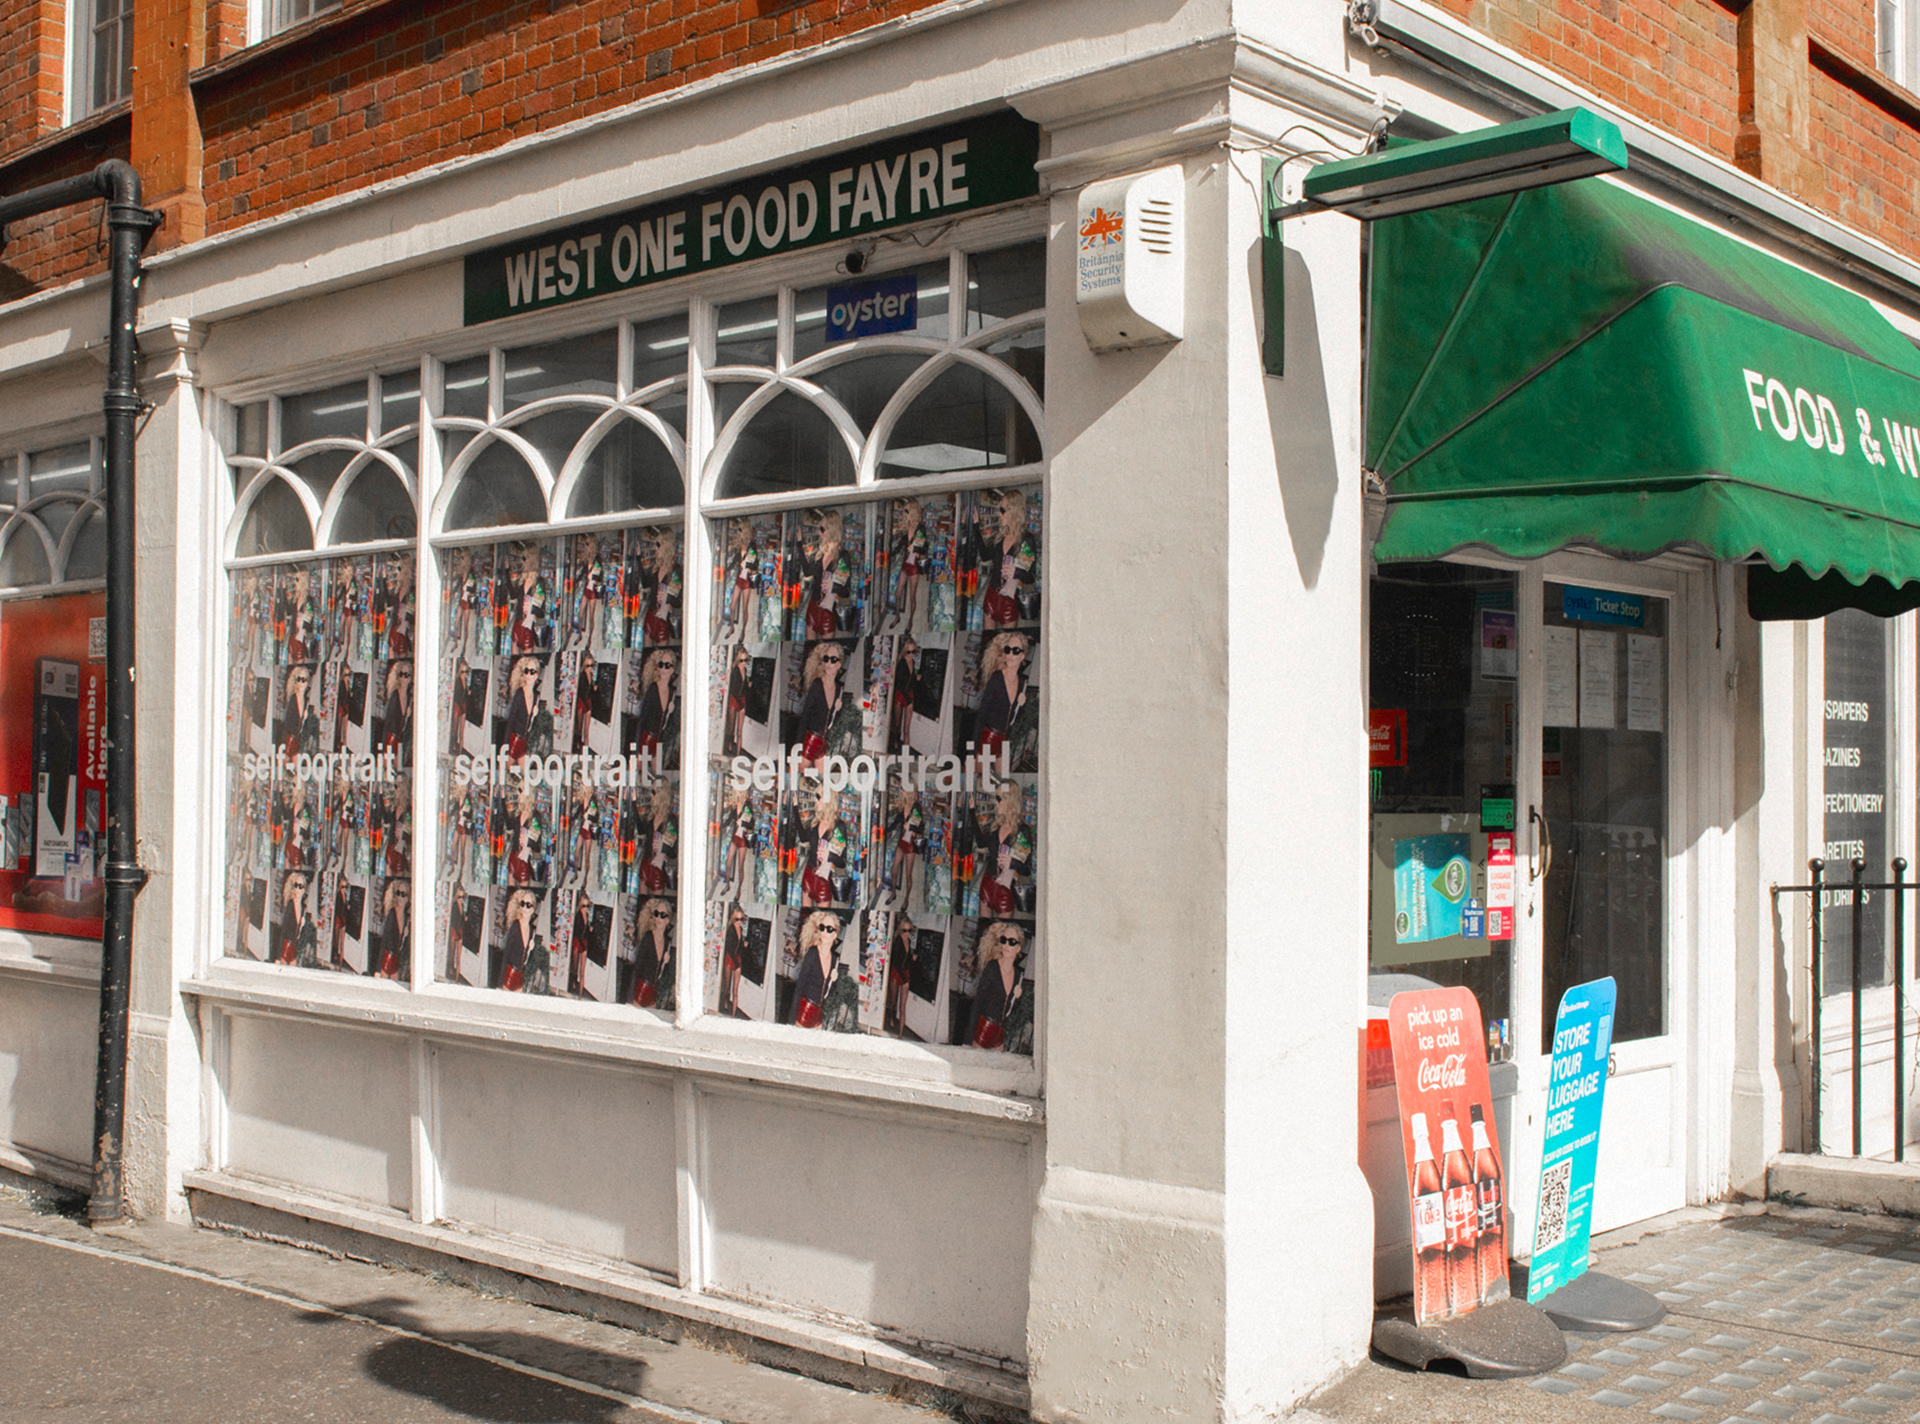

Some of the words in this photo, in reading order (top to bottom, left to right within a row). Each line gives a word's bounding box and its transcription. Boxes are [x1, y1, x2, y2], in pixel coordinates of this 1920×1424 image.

[505, 236, 602, 308] WEST
[611, 210, 687, 284] ONE
[701, 179, 819, 262] FOOD
[830, 138, 970, 233] FAYRE
[1079, 250, 1124, 270] Britannia
[1080, 264, 1122, 280] Security
[1081, 275, 1122, 292] Systems
[831, 291, 911, 332] oyster
[1743, 367, 1846, 456] FOOD
[1855, 407, 1886, 467] &
[1595, 597, 1619, 614] Ticket
[1620, 602, 1640, 618] Stop
[1824, 700, 1869, 722] SPAPERS
[85, 675, 97, 781] Available
[98, 724, 107, 780] Here
[1823, 747, 1860, 767] AZINES
[455, 742, 663, 796] self-portrait!
[731, 741, 1010, 802] self-portrait!
[1824, 793, 1884, 813] FECTIONERY
[1823, 840, 1865, 860] ARETTES
[1451, 864, 1459, 894] VELO
[1491, 872, 1511, 880] LUGGAGE
[1495, 893, 1507, 901] HERE
[1834, 888, 1870, 906] DRIS
[1407, 1004, 1432, 1032] pick
[1432, 1008, 1448, 1028] up
[1449, 1006, 1463, 1022] an
[1417, 1032, 1434, 1050] ice
[1436, 1026, 1460, 1048] cold
[1555, 1022, 1592, 1055] STORE
[1417, 1053, 1467, 1093] Coca-Cola
[1552, 1052, 1583, 1082] YOUR
[1548, 1071, 1600, 1111] LUGGAGE
[1546, 1107, 1576, 1140] HERE
